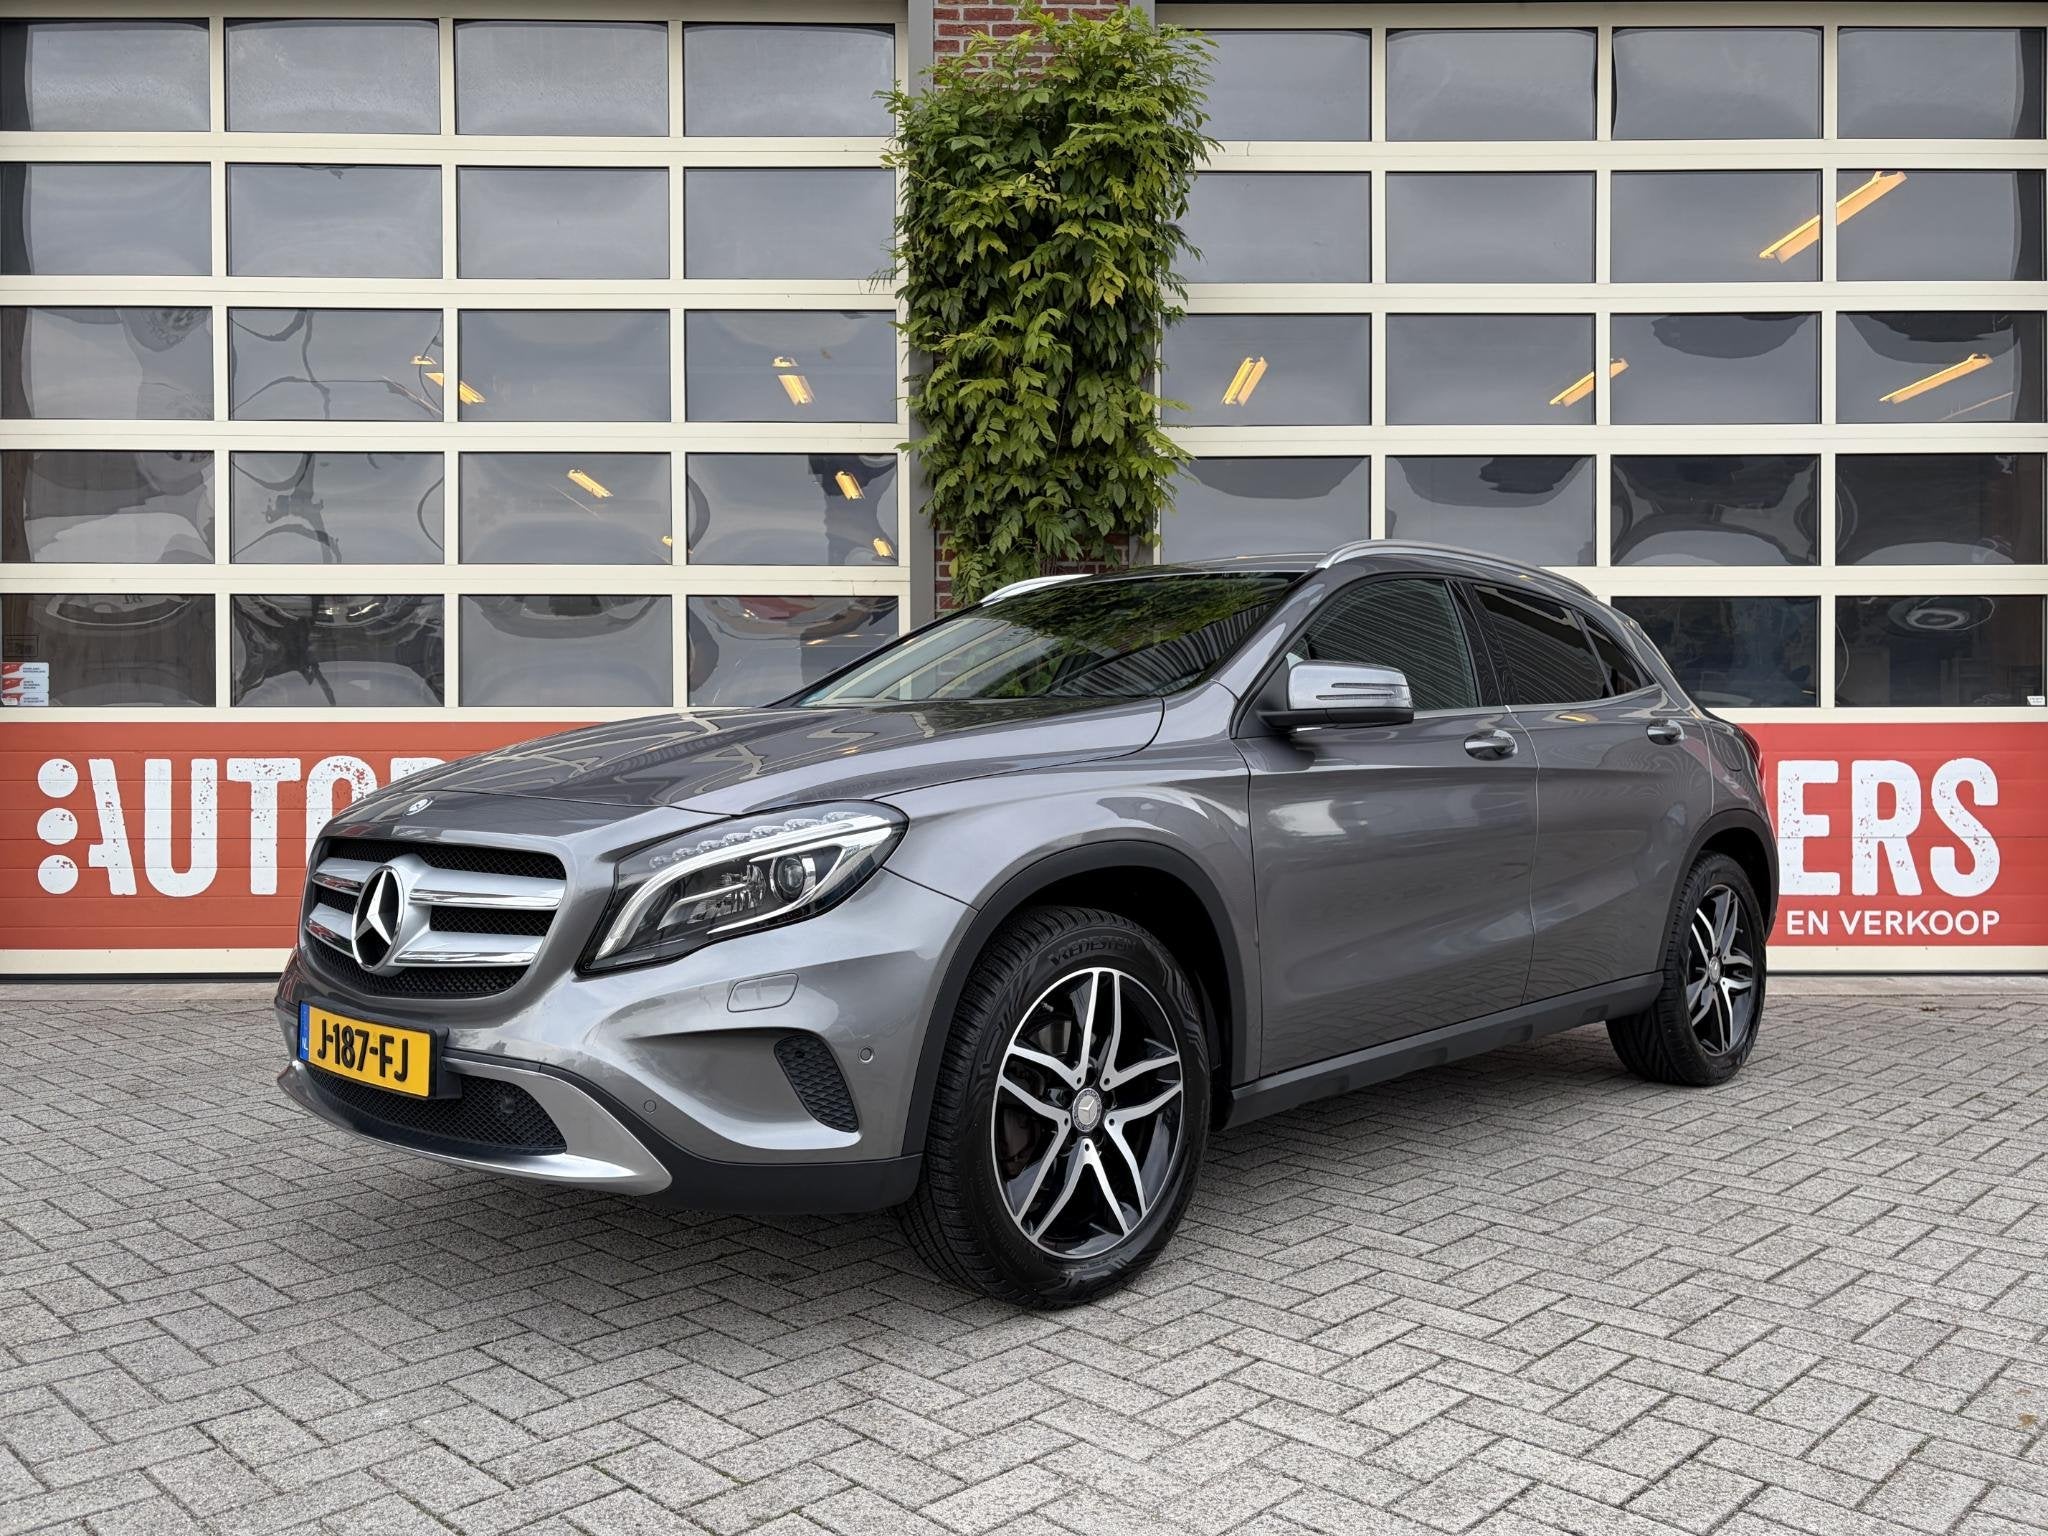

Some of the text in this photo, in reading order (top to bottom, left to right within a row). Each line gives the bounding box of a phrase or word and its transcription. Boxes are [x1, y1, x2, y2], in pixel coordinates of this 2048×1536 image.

[38, 756, 446, 897] AUTO
[1787, 910, 2000, 935] EN VERKOOP
[317, 1019, 408, 1082] J-187-FJ
